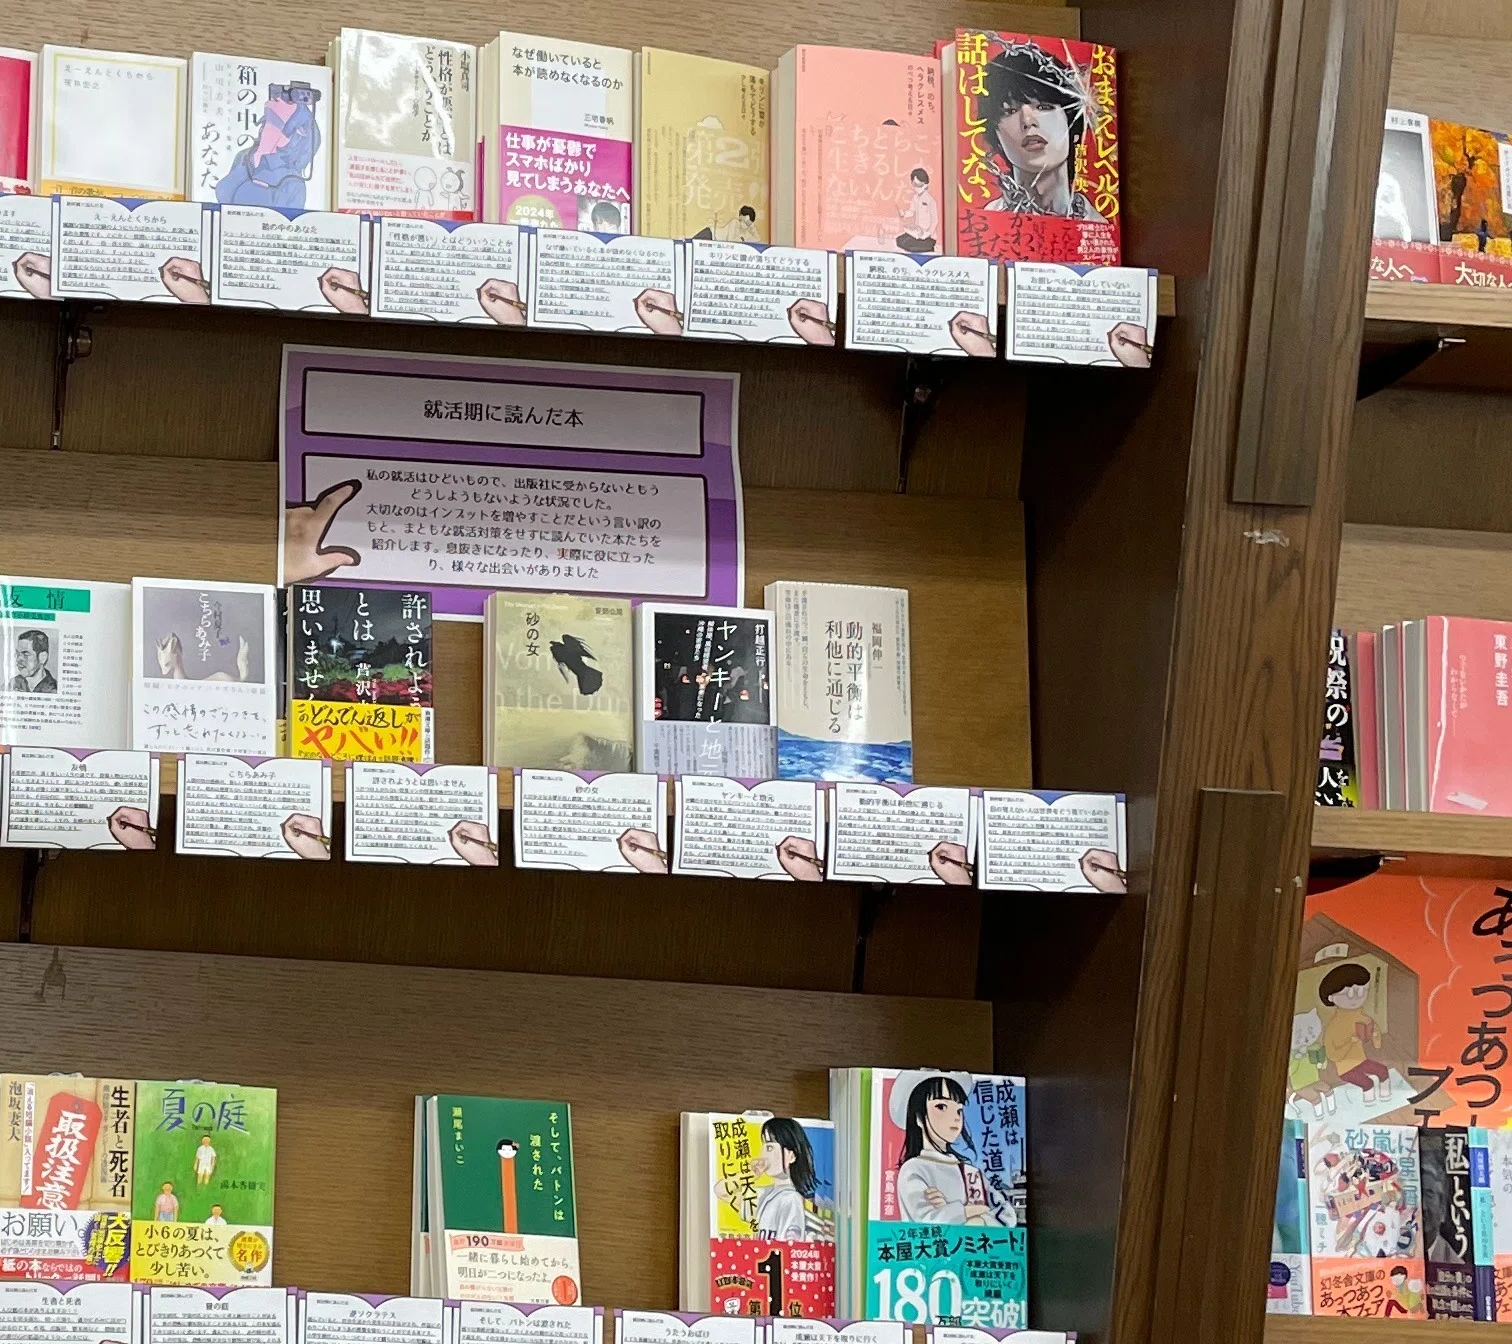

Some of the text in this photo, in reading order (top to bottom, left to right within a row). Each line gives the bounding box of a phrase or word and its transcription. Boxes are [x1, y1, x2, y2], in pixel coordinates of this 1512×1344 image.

[512, 46, 602, 71] なぜ働いていると
[512, 64, 624, 91] 本が読めなくなるのか
[237, 64, 258, 149] 箱の中の
[955, 33, 990, 203] 話はしてない
[201, 121, 221, 190] あなた
[505, 132, 597, 159] 仕事が憂鬱で
[1092, 44, 1119, 219] おまえレベルの
[505, 153, 591, 178] スマホばかり
[505, 170, 630, 203] 見てしまうあなたへ
[423, 399, 584, 428] 就活期に読んだ本
[428, 559, 599, 580] り、様々な出会いがありました
[195, 592, 212, 662] こちらあみ子
[354, 592, 374, 641] とは
[525, 612, 541, 657] 砂の女
[825, 619, 843, 734] 利他に通じる
[156, 1088, 249, 1135] 夏の庭
[996, 1080, 1021, 1146] 成瀬は
[36, 1110, 87, 1211] 取扱注意
[109, 1085, 130, 1198] 生者と死者
[973, 1080, 1007, 1226] 信じた道をいく
[548, 1112, 565, 1222] そして、バトンは
[713, 1122, 741, 1213] 取りにいく
[731, 1118, 759, 1231] 成瀬は天下を
[1, 1212, 85, 1239] お願い。
[466, 1235, 489, 1247] 190
[898, 1228, 942, 1241] 2年連続
[136, 1242, 224, 1260] とびきりあつくて
[150, 1262, 209, 1279] 少し苦い。
[235, 1250, 262, 1263] 名作
[873, 1268, 963, 1324] 180
